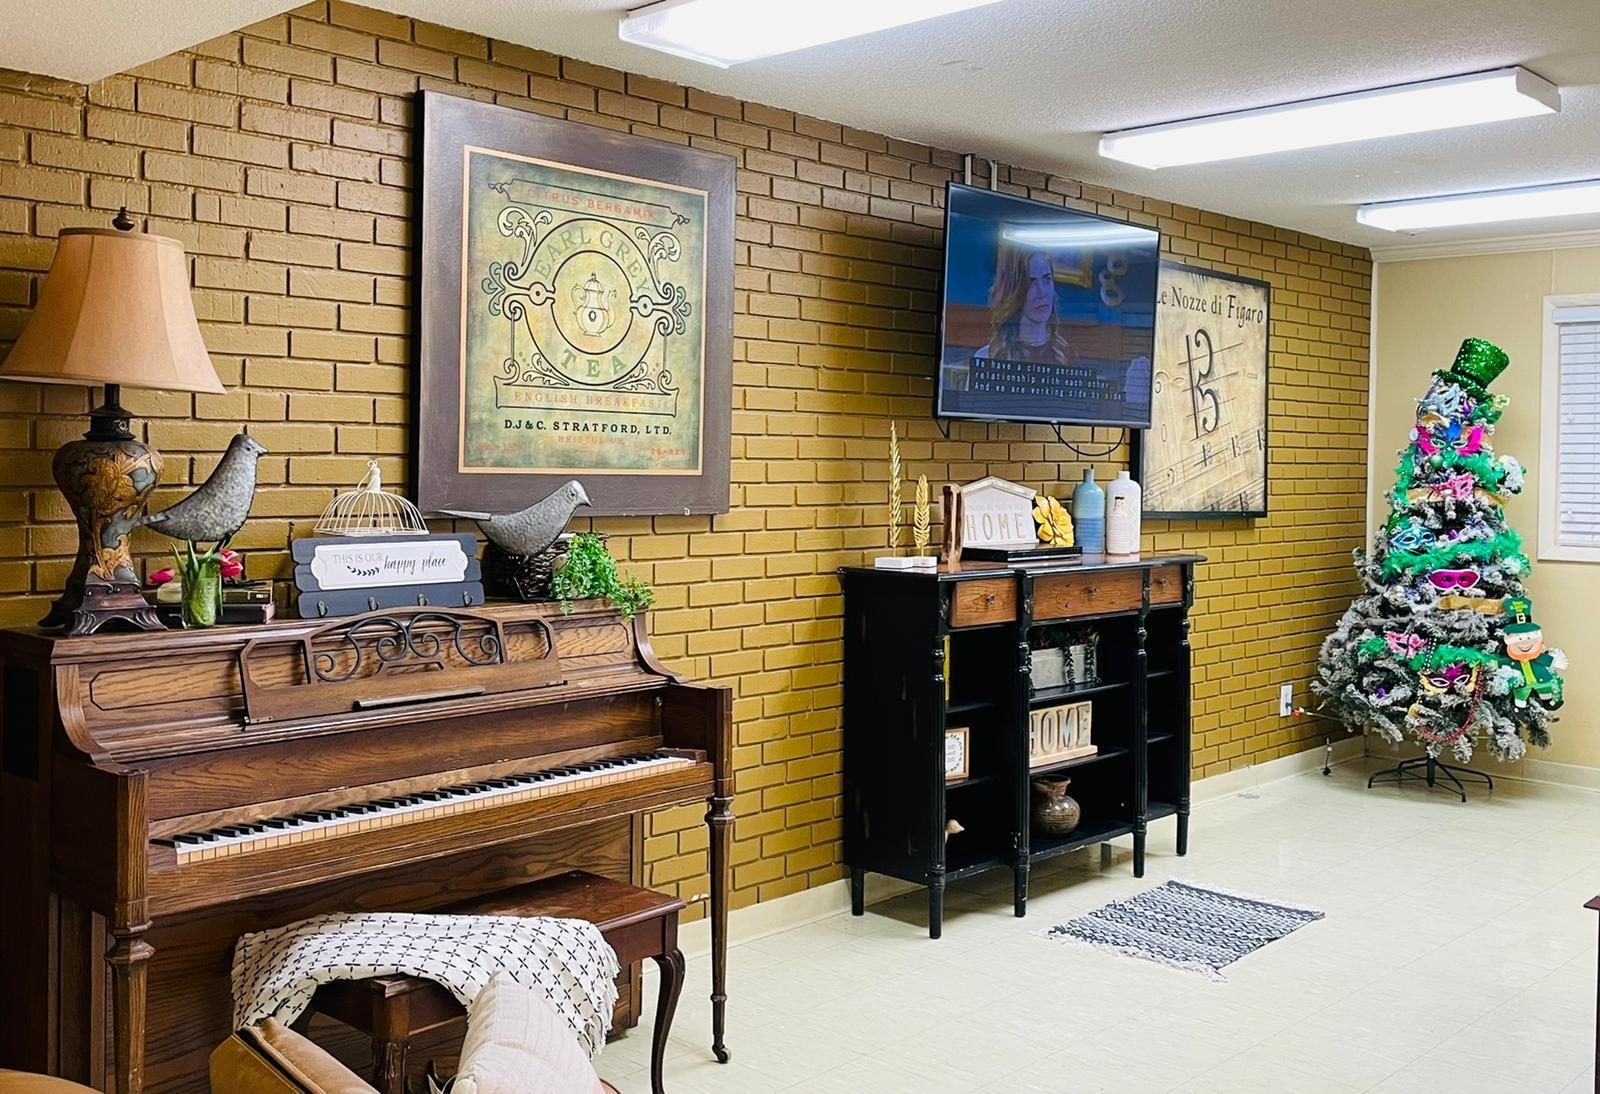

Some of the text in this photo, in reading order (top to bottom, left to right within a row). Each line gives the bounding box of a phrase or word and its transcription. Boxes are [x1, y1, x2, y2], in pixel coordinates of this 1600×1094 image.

[534, 225, 650, 292] EARL GREY
[1171, 286, 1207, 313] Nozze
[1211, 294, 1222, 315] di
[1225, 294, 1264, 328] Figaro
[561, 348, 627, 378] TEA
[991, 360, 1012, 370] have
[1056, 367, 1092, 377] personal
[975, 371, 1036, 384] relationship
[1041, 375, 1060, 385] with
[1065, 379, 1083, 387] each
[514, 391, 577, 405] ENGLISH
[975, 381, 990, 392] And
[1011, 386, 1026, 394] are
[1031, 386, 1064, 398] working
[553, 421, 640, 435] STRATFORD,
[645, 425, 672, 436] LTD.
[965, 512, 1026, 541] HOME
[333, 552, 383, 564] THIS IS OUR
[384, 552, 448, 575] happy place
